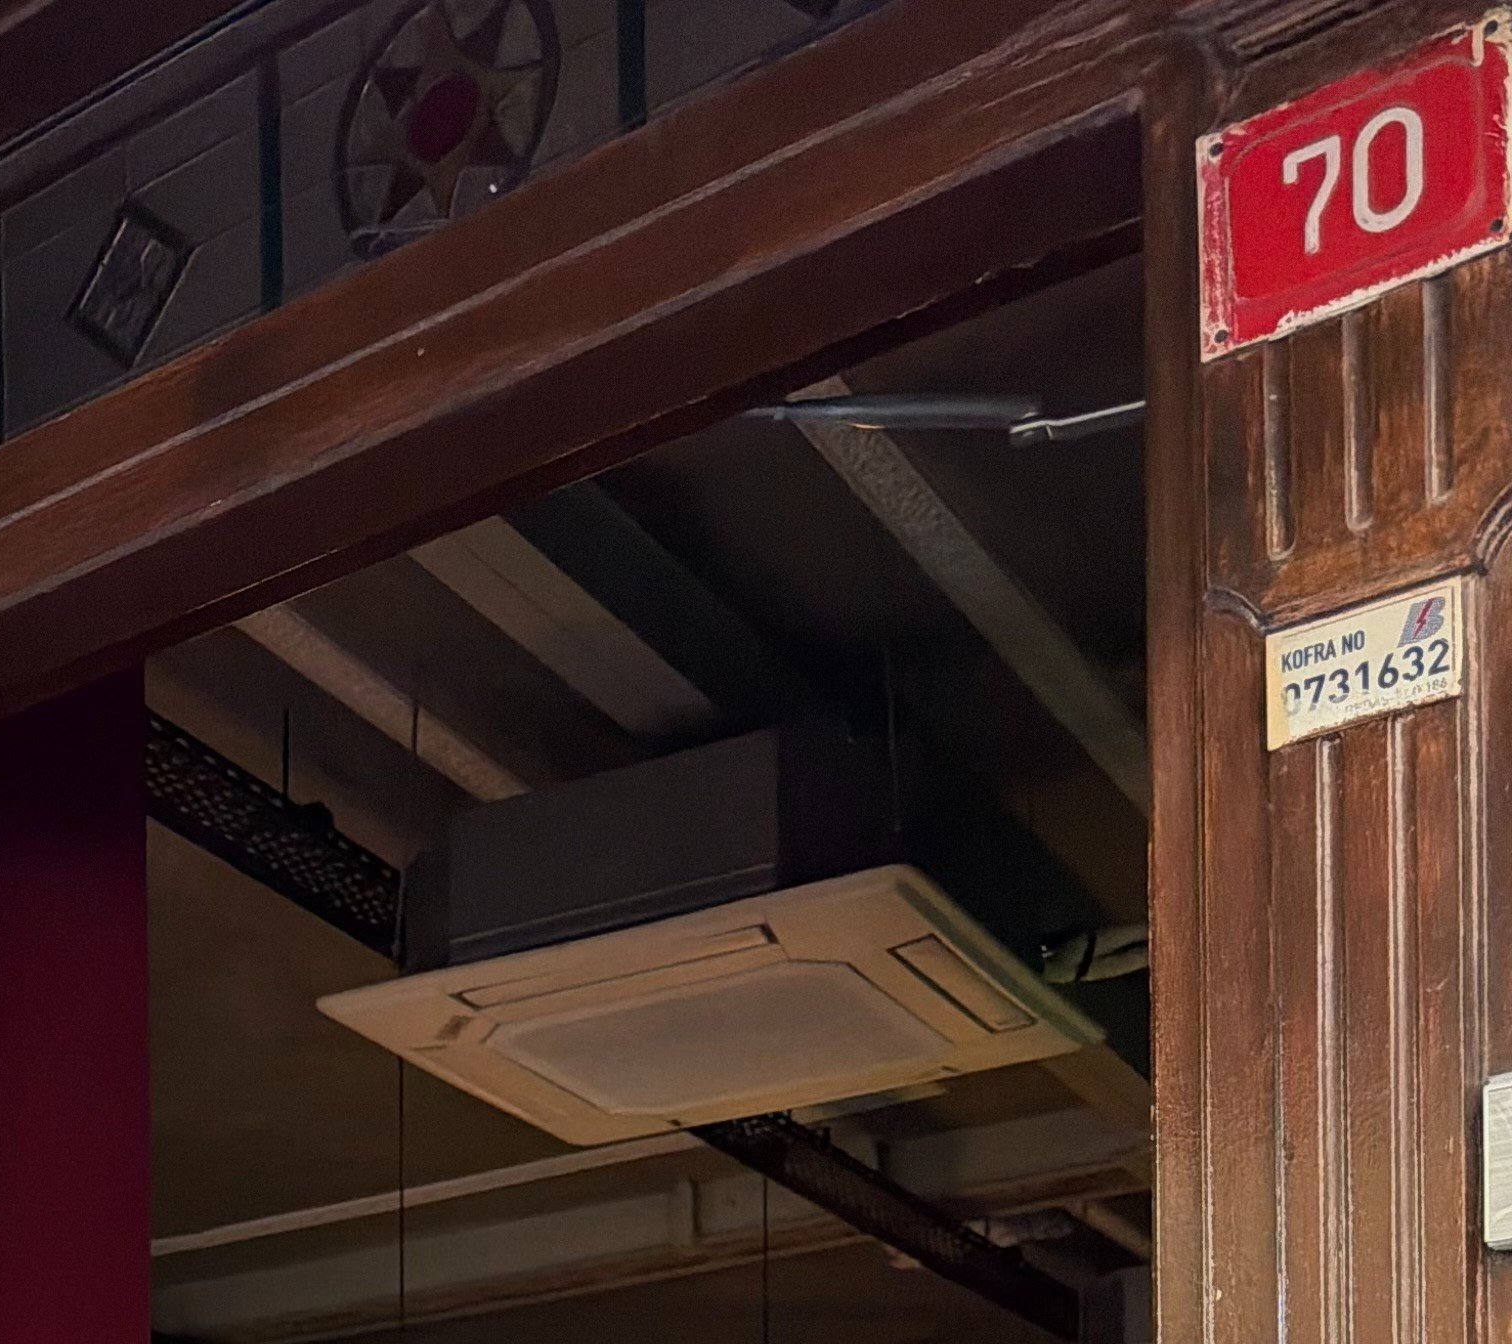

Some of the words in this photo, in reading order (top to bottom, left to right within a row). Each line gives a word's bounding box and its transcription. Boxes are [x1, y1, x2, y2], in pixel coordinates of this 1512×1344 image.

[1282, 106, 1424, 255] 70
[1281, 638, 1336, 673] KOFRA
[1341, 630, 1366, 655] NO
[1282, 637, 1450, 716] 0731632
